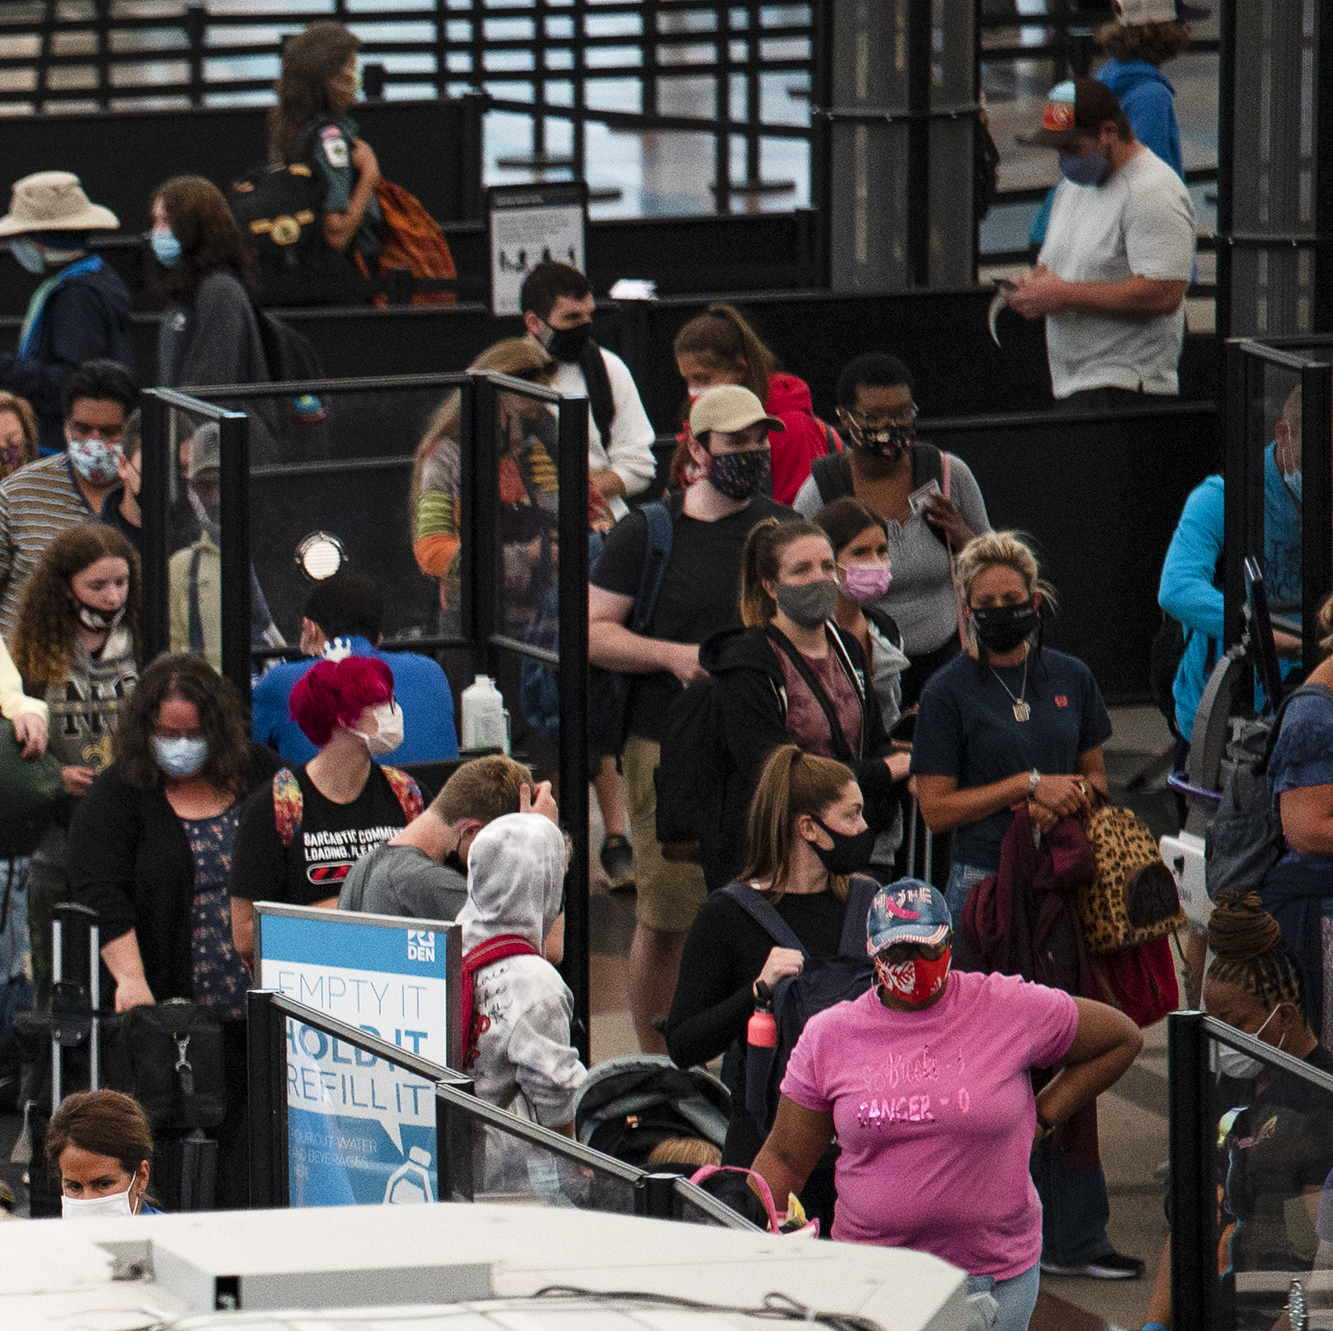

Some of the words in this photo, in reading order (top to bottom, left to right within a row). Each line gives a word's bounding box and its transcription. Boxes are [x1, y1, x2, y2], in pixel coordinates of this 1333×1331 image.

[304, 829, 358, 847] SARCASTIC
[407, 946, 435, 962] DEN
[278, 970, 390, 1015] EMPTY
[402, 984, 428, 1020] IT
[287, 1063, 387, 1111] REFILL
[395, 1082, 431, 1115] IT
